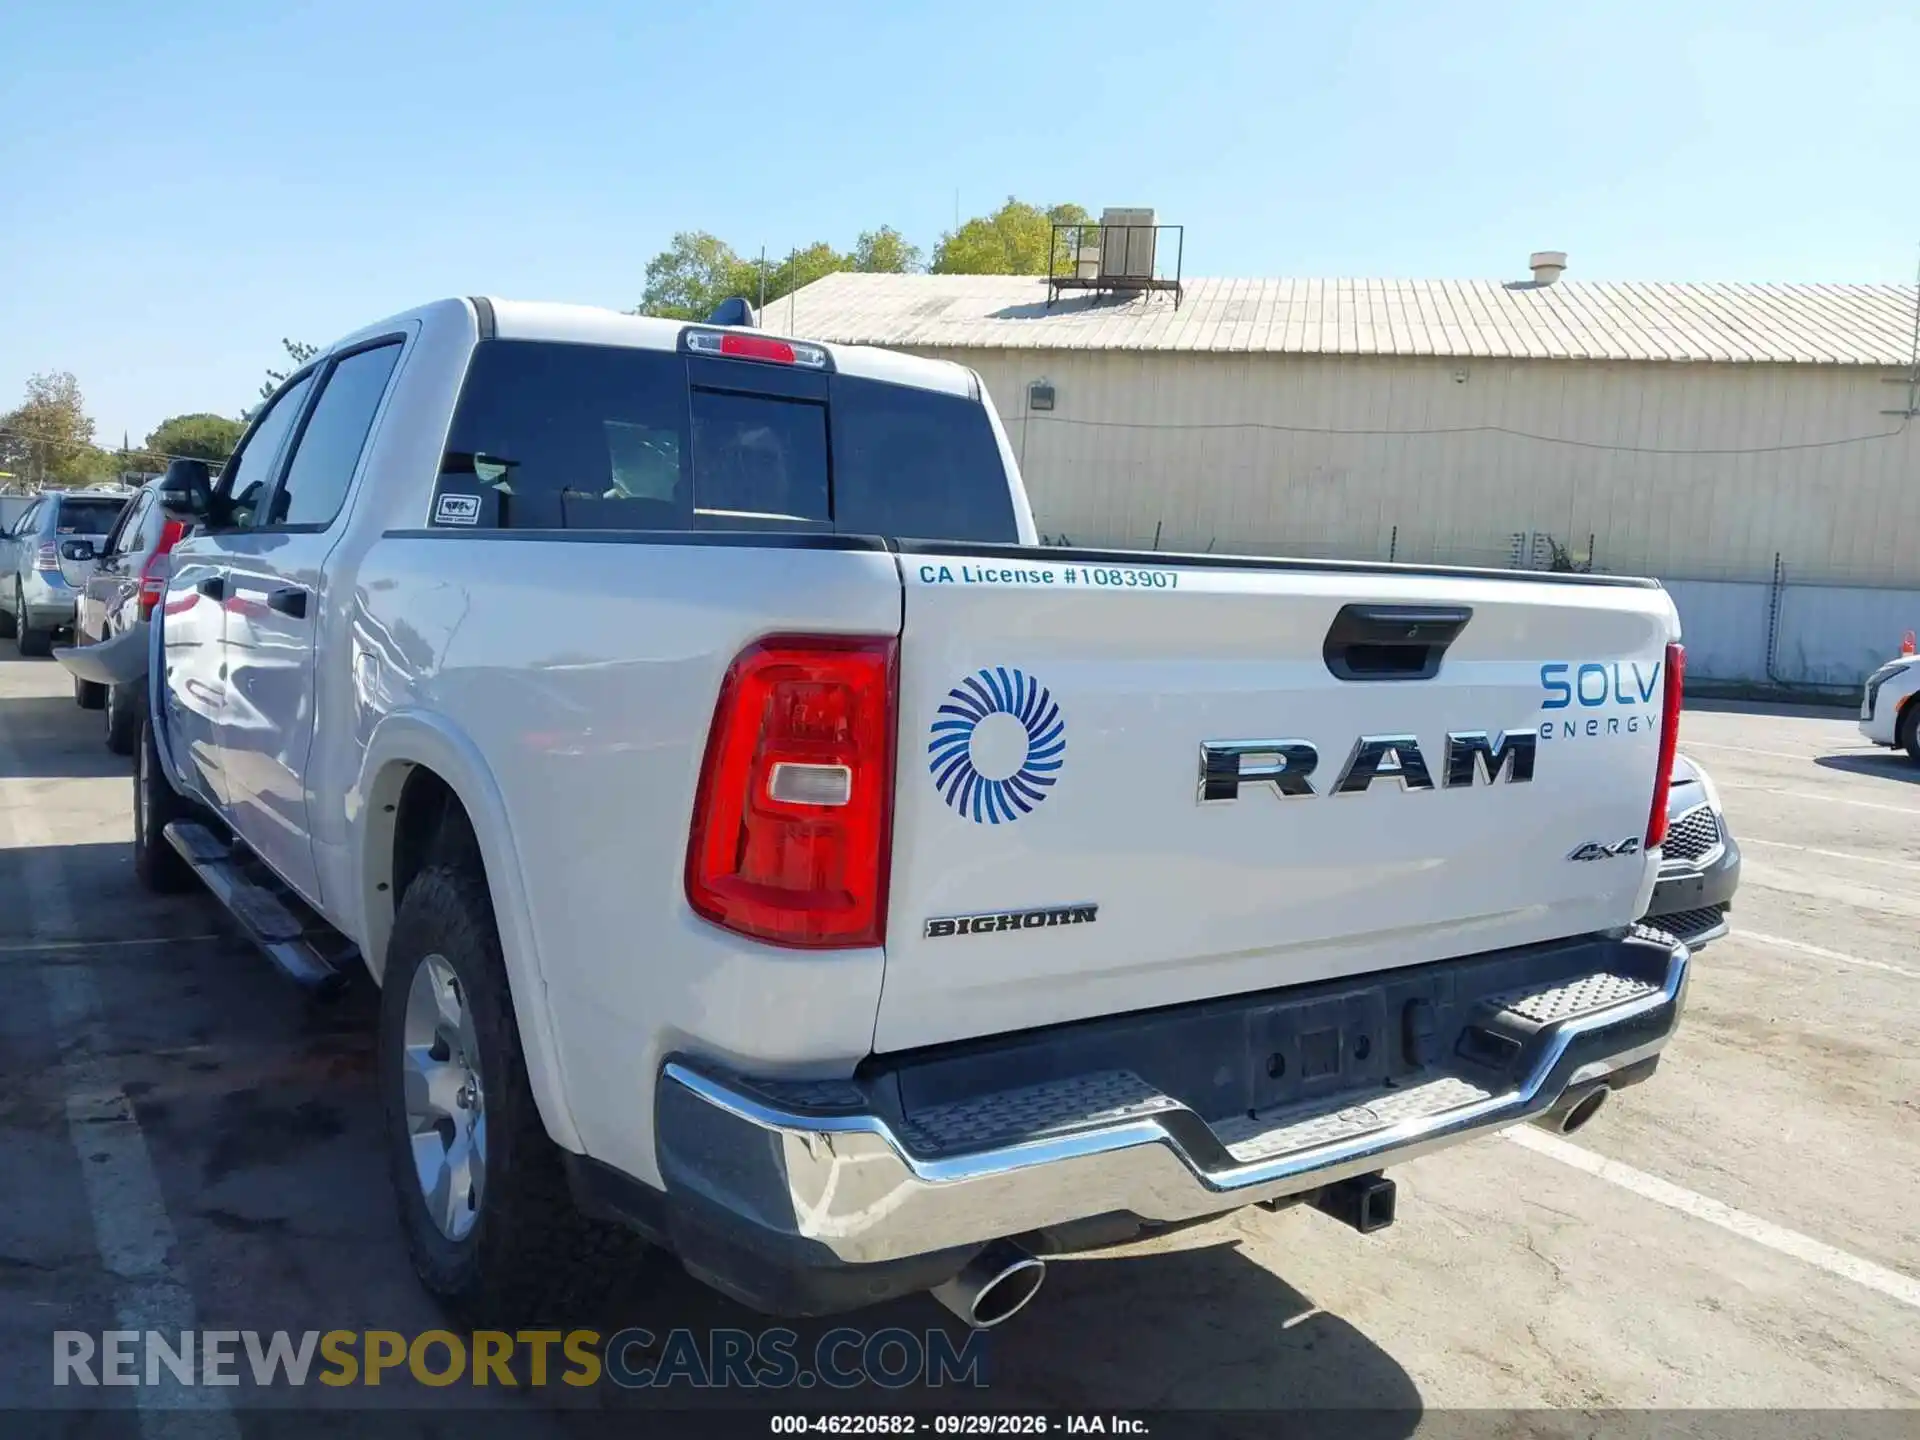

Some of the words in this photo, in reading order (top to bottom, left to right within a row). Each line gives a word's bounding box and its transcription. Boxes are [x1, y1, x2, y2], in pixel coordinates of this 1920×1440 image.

[919, 565, 954, 584] CA
[962, 565, 1055, 585] License
[1063, 567, 1179, 589] #1083907
[1540, 661, 1660, 709] SOLV
[1197, 729, 1538, 807] RAM
[924, 903, 1099, 939] BIGHORN
